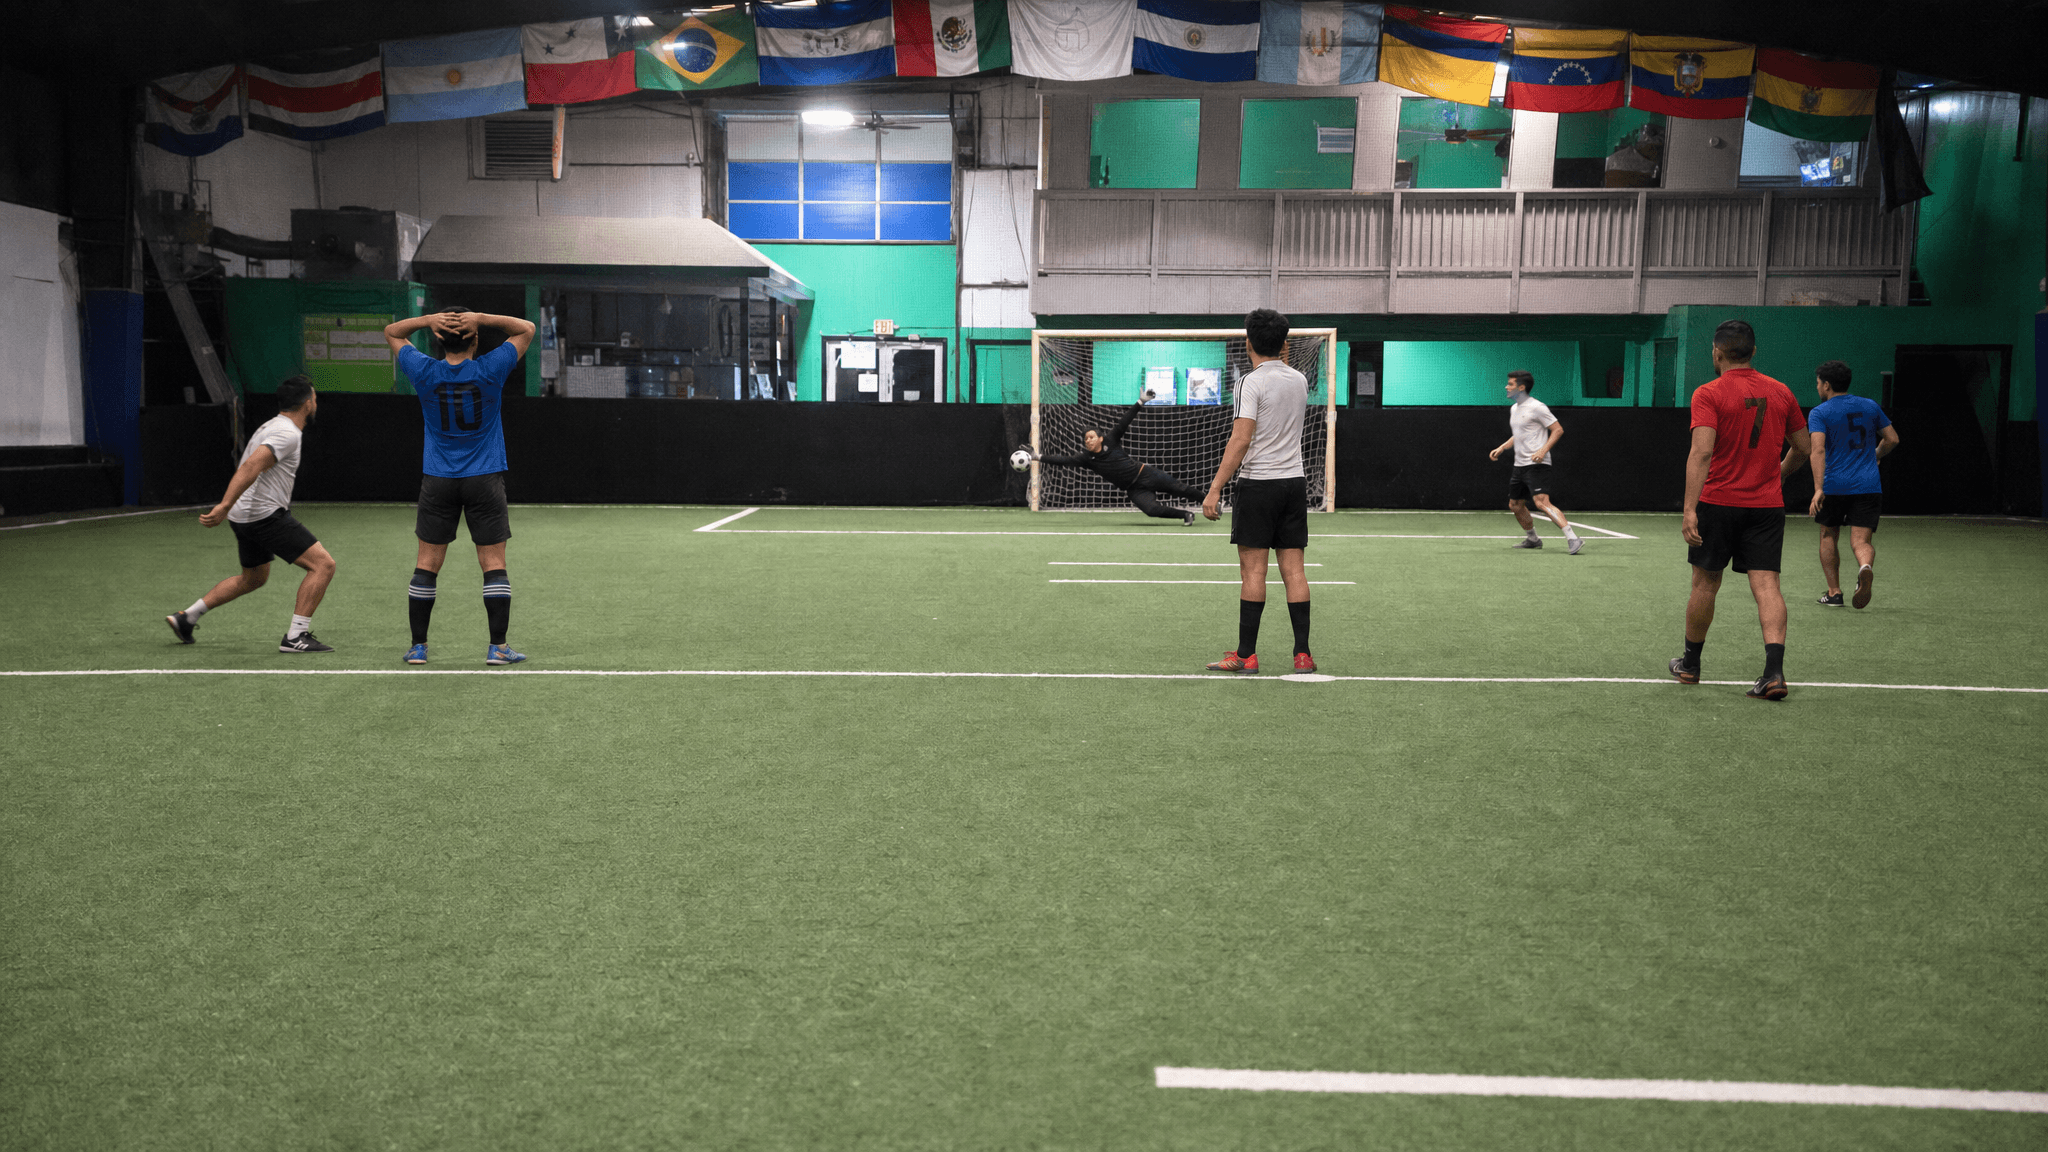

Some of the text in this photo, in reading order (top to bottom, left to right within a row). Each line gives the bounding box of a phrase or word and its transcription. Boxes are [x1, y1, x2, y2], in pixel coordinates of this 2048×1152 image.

[433, 382, 482, 431] 10
[1744, 398, 1767, 449] 7
[1846, 412, 1867, 450] 5
